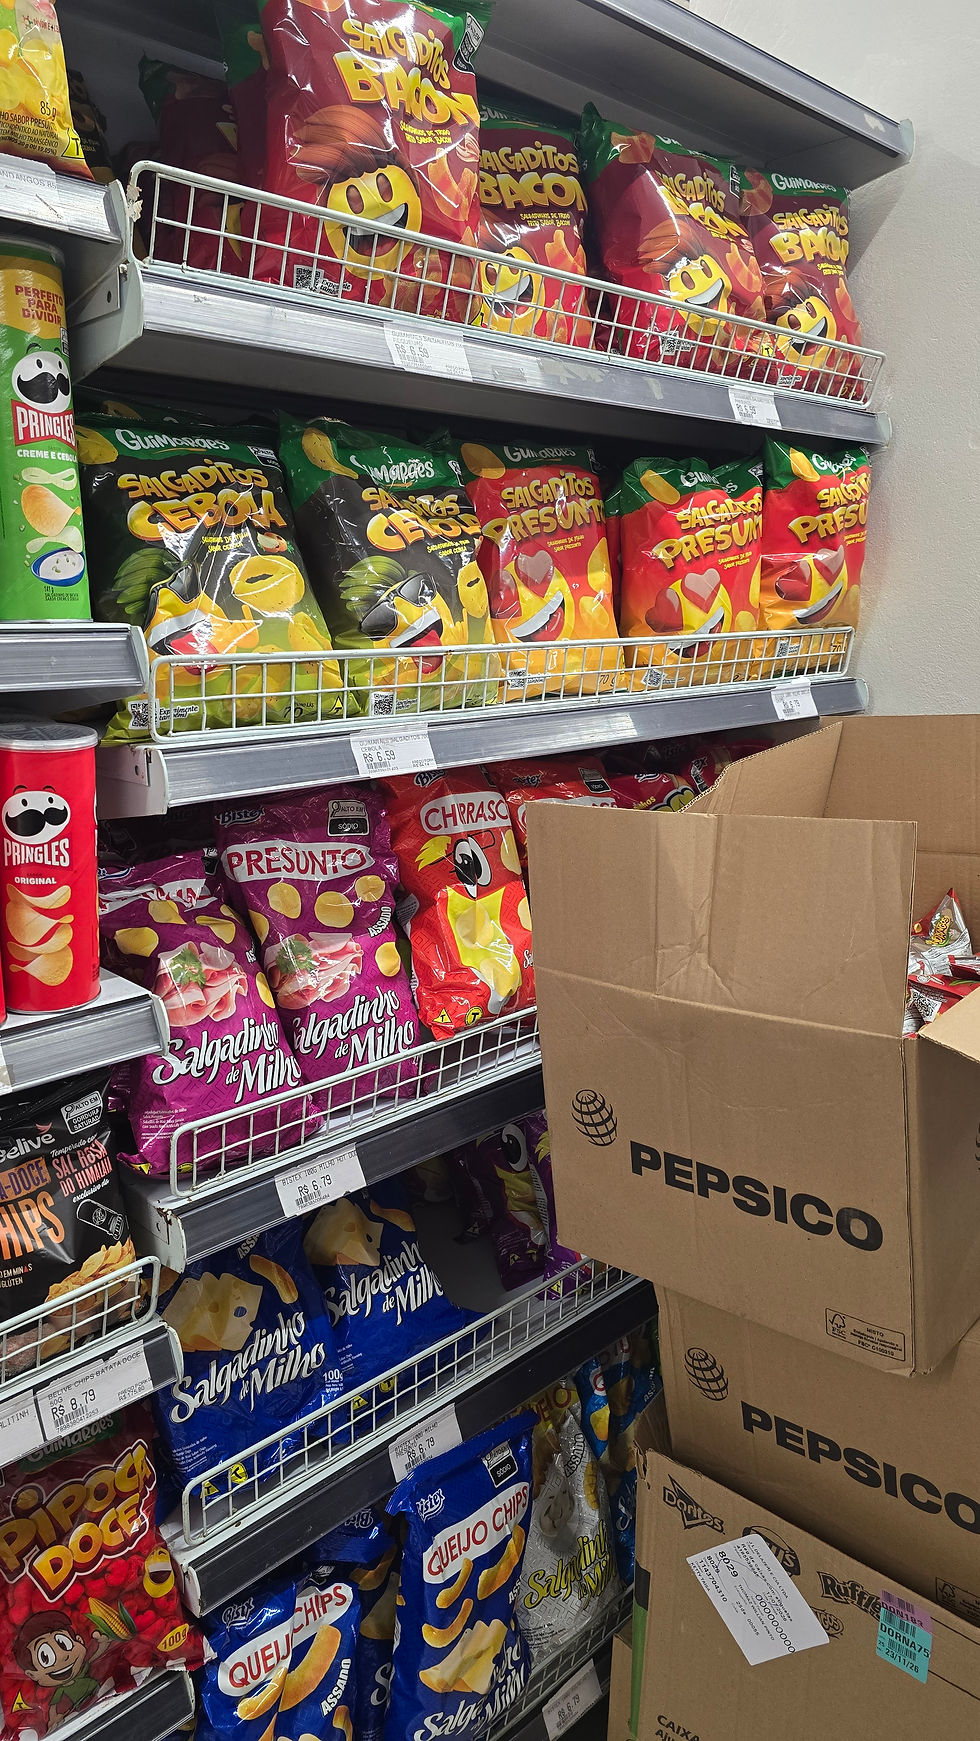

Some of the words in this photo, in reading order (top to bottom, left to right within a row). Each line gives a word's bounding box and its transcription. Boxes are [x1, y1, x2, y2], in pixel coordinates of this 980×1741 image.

[333, 50, 480, 126] BACON
[10, 113, 30, 126] SABOR
[40, 101, 51, 116] 85
[14, 285, 64, 306] PERFEITO
[27, 297, 58, 314] PARA
[16, 406, 76, 447] PRINGLES
[17, 449, 49, 459] CREME
[51, 451, 56, 460] E
[127, 489, 288, 541] CEBOLA
[363, 752, 374, 763] R$
[377, 749, 396, 761] 6.59
[215, 806, 266, 827] Bistex
[4, 838, 70, 867] PRINGLES
[227, 847, 366, 876] PRESUNTO
[14, 876, 57, 885] ORIGINAL
[367, 905, 393, 938] ASSADO
[152, 1013, 279, 1084] Salgadinho
[334, 1042, 349, 1060] de
[347, 1016, 415, 1072] Milho
[226, 1066, 239, 1084] de
[233, 1052, 302, 1104] Milho
[76, 1100, 89, 1110] ALTO
[51, 1138, 88, 1158] Temperado
[52, 1156, 77, 1180] SAL
[77, 1139, 108, 1167] ROSA
[59, 1178, 76, 1197] DO
[77, 1156, 113, 1188] HIMALAIA
[282, 1174, 302, 1187] BISTEX
[319, 1158, 336, 1171] MILHO
[337, 1154, 347, 1164] HOT
[298, 1184, 309, 1197] R$
[312, 1174, 332, 1192] 6.79
[73, 1182, 102, 1203] exclusivo
[629, 1140, 884, 1252] PEPSICO
[382, 1295, 395, 1313] de
[47, 1382, 73, 1400] BELIVE
[74, 1372, 95, 1388] CHIPS
[95, 1358, 122, 1377] BATATA
[122, 1349, 141, 1363] DOCE
[170, 1310, 306, 1424] Salgadinho
[240, 1381, 250, 1402] de
[250, 1343, 326, 1411] Milho
[49, 1396, 63, 1408] 50G
[51, 1404, 66, 1420] R$
[69, 1388, 96, 1411] 8.79
[407, 1449, 416, 1461] R$
[418, 1436, 435, 1454] 6.79
[564, 1433, 585, 1478] ASSADO
[741, 1400, 980, 1535] PEPSICO
[663, 1486, 723, 1534] Doritos
[33, 1493, 142, 1590] DOCE
[427, 1520, 488, 1576] QUEIJO
[492, 1485, 528, 1532] CHIPS
[718, 1550, 739, 1578] 8029
[293, 1585, 347, 1633] CHIPS
[161, 1627, 187, 1650] 100g
[763, 1624, 775, 1641] PINTO
[880, 1623, 930, 1658] DORNA75
[885, 1648, 920, 1674] 23/11/26
[321, 1658, 351, 1717] ASSADO
